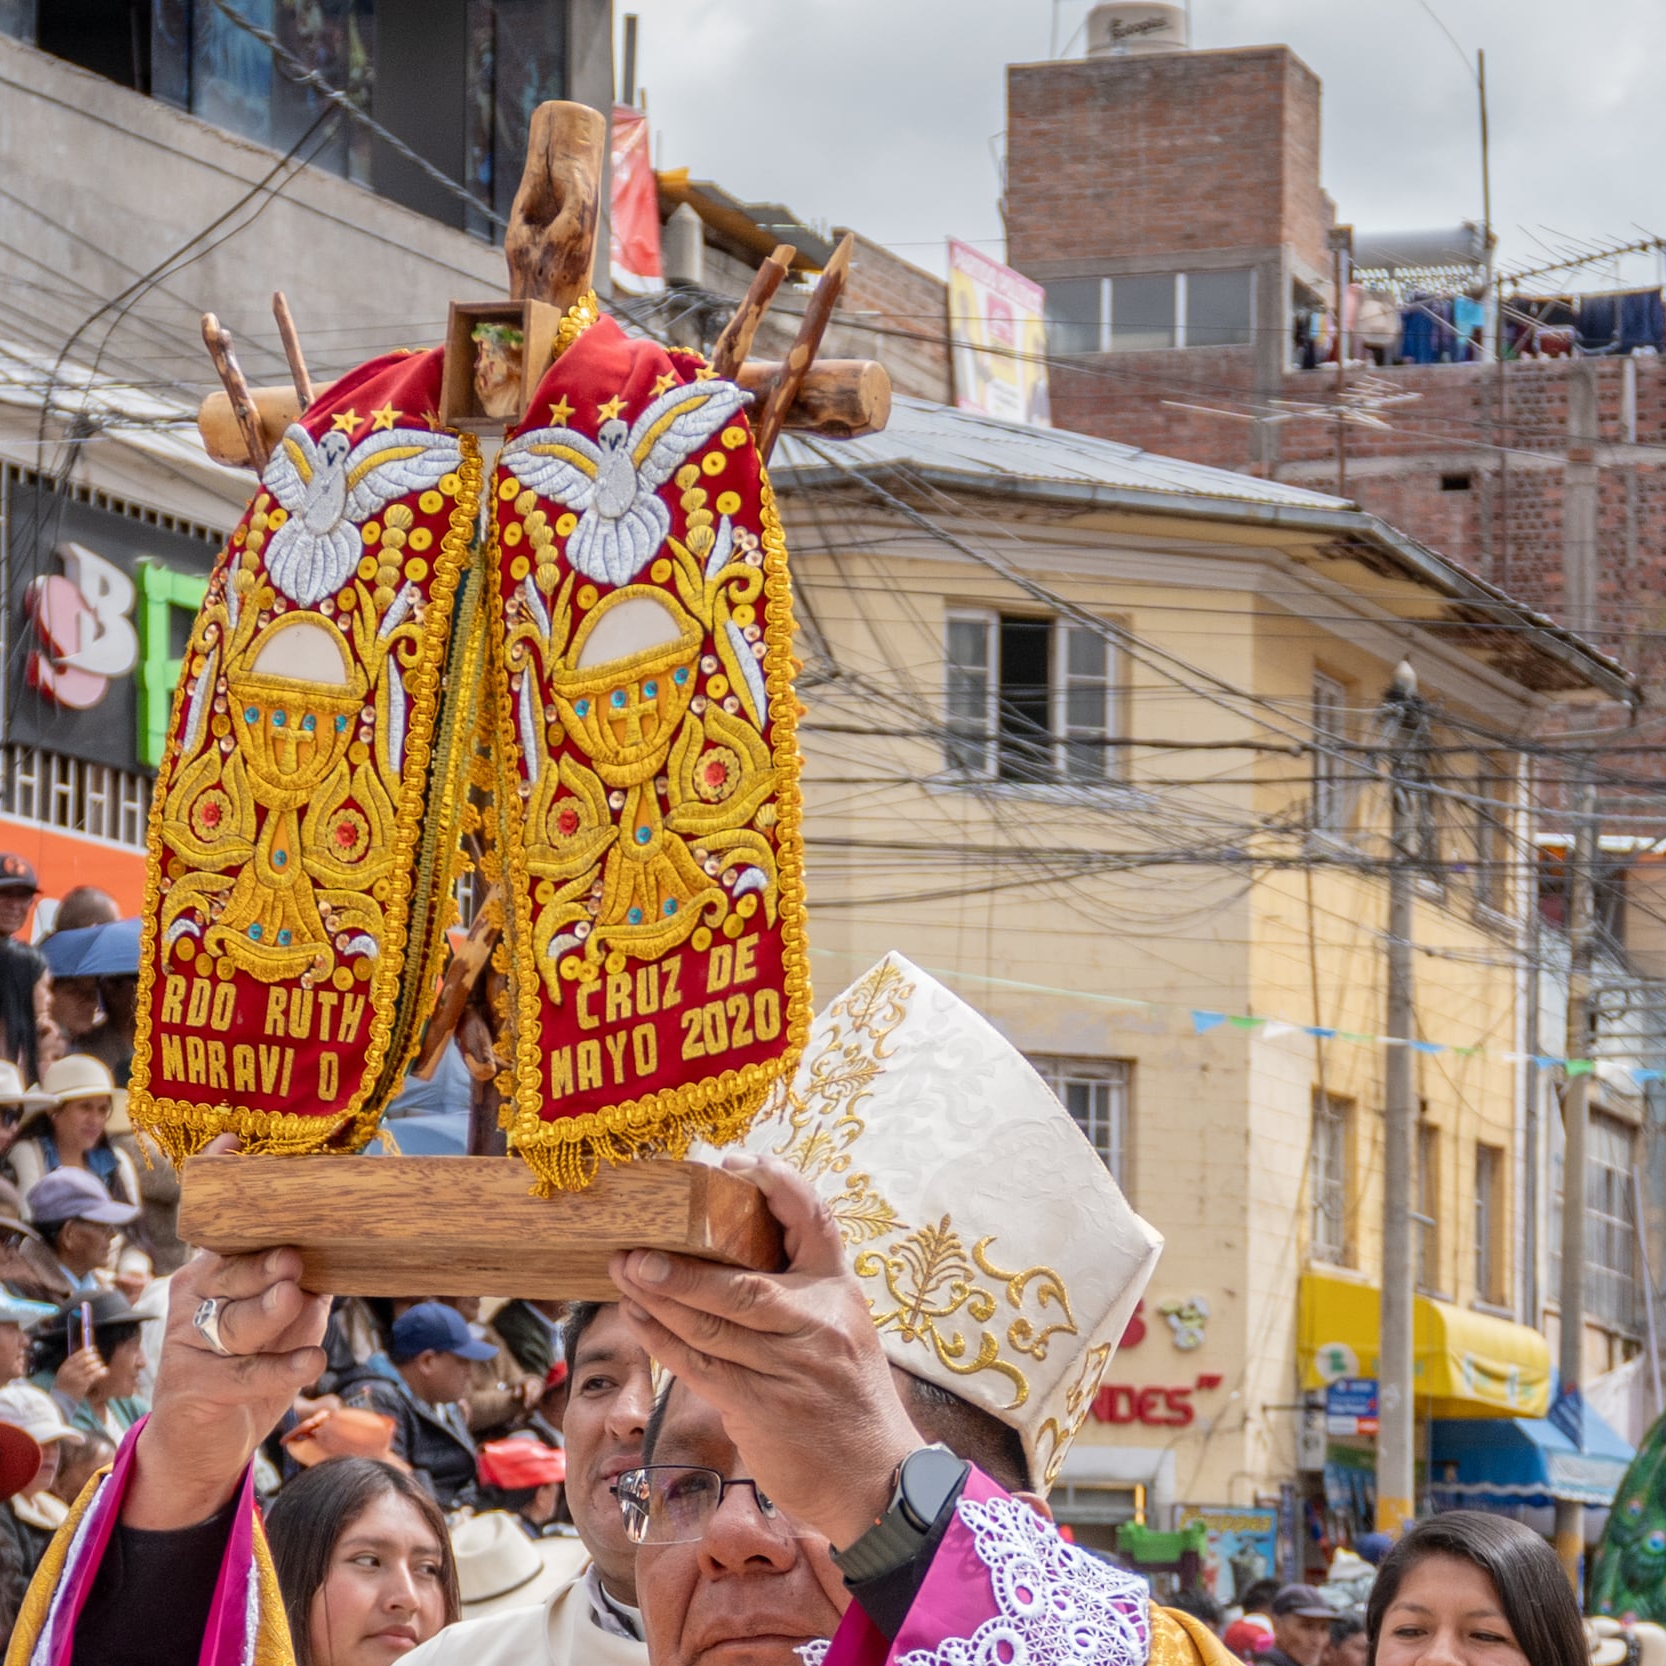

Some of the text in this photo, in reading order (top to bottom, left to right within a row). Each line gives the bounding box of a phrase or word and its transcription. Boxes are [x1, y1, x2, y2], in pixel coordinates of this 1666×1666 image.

[161, 974, 366, 1044] RDO RUTH
[575, 932, 760, 1030] CRUZ DE
[550, 988, 782, 1100] MAYO 2020
